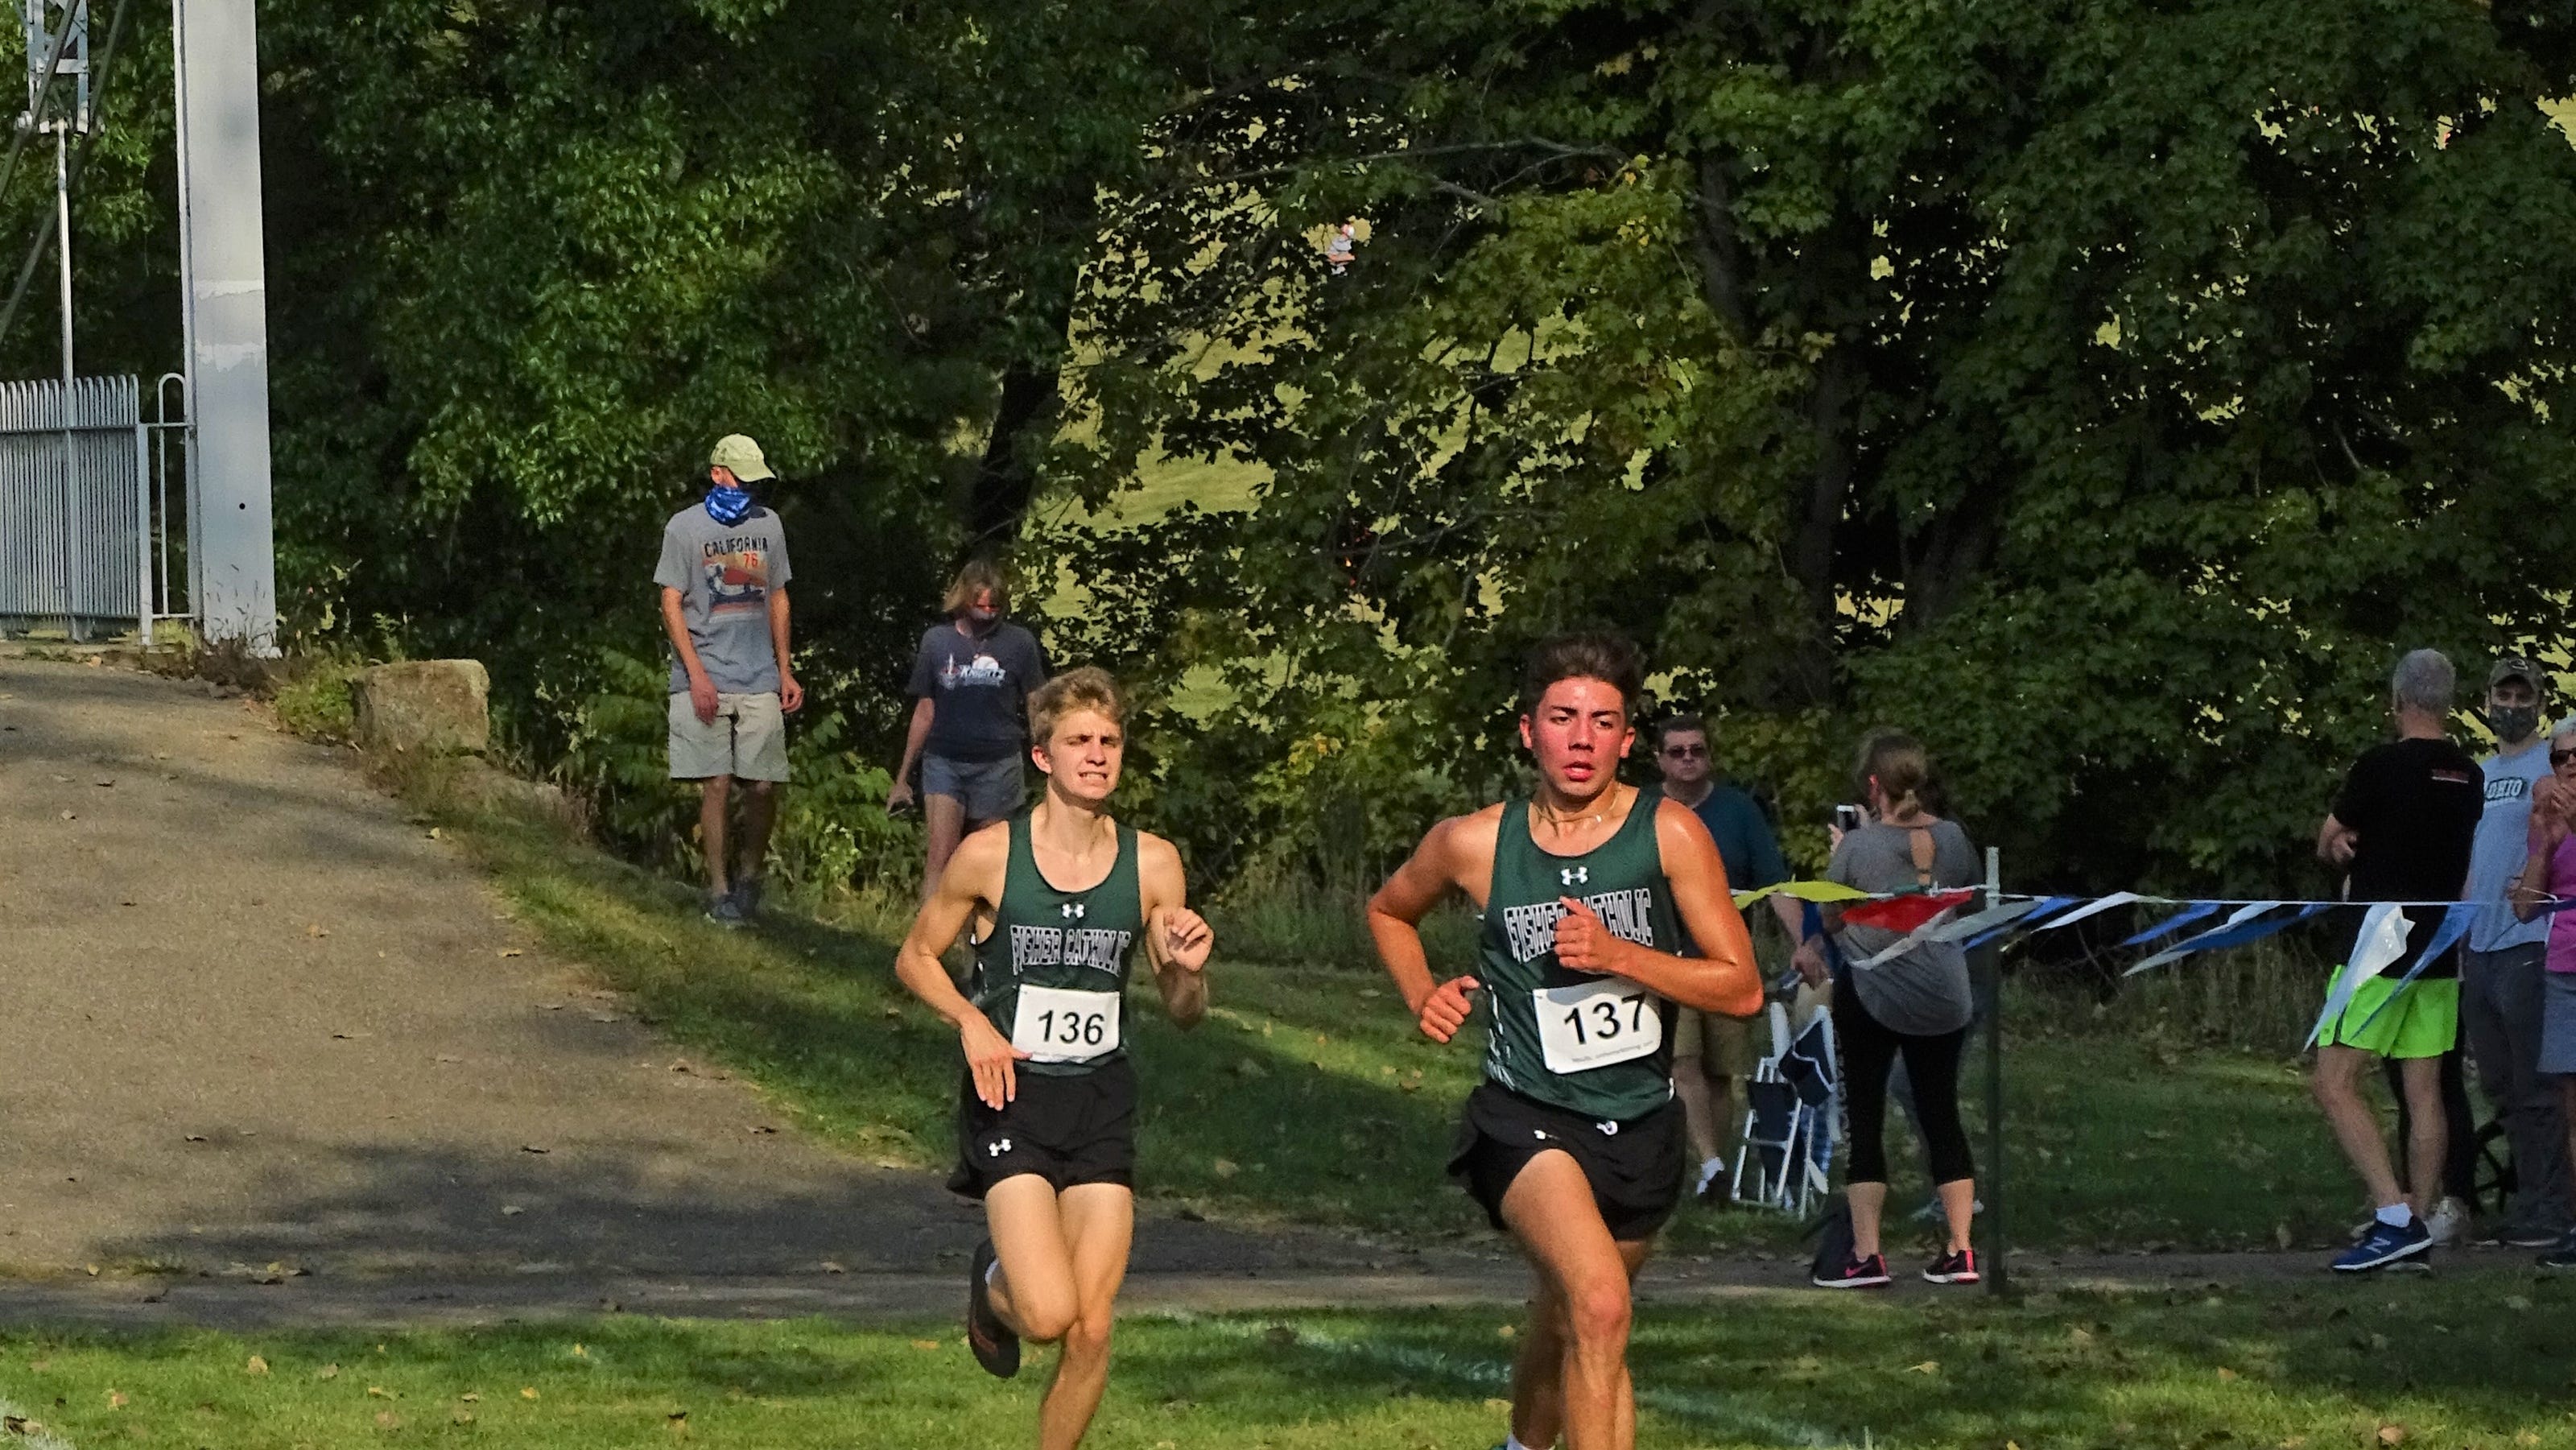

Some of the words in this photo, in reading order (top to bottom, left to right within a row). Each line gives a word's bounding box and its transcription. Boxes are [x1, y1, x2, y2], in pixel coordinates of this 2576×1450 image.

[704, 535, 768, 557] CALIFORNIA
[743, 552, 758, 568] 76
[2485, 778, 2524, 799] OHIO
[1038, 1010, 1105, 1045] 136
[1564, 992, 1647, 1045] 137
